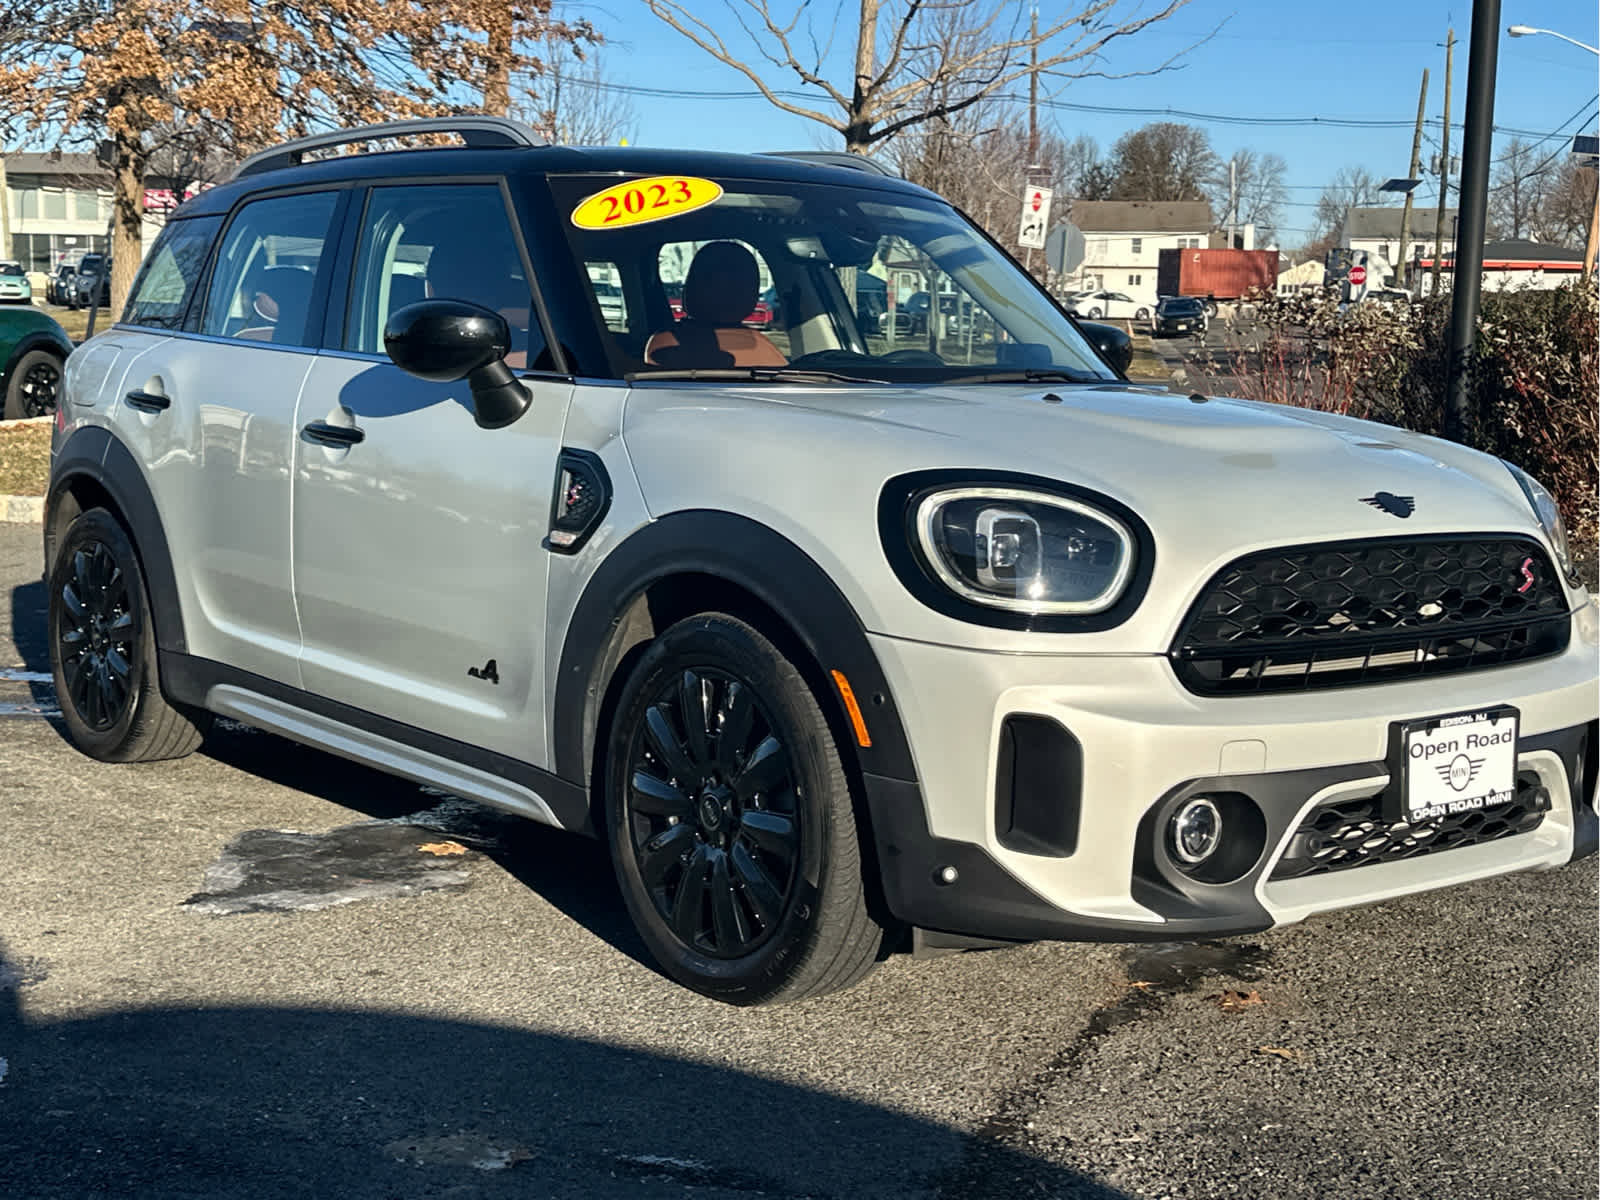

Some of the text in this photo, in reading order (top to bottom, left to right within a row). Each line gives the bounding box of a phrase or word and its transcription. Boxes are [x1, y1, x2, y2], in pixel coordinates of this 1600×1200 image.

[600, 181, 691, 223] 2023
[1350, 271, 1366, 280] STOP
[1517, 557, 1534, 592] S
[1475, 713, 1488, 722] NJ
[1410, 728, 1512, 760] Open Road
[1451, 767, 1469, 778] MINI
[1413, 791, 1512, 820] OPEN ROAD MINI
